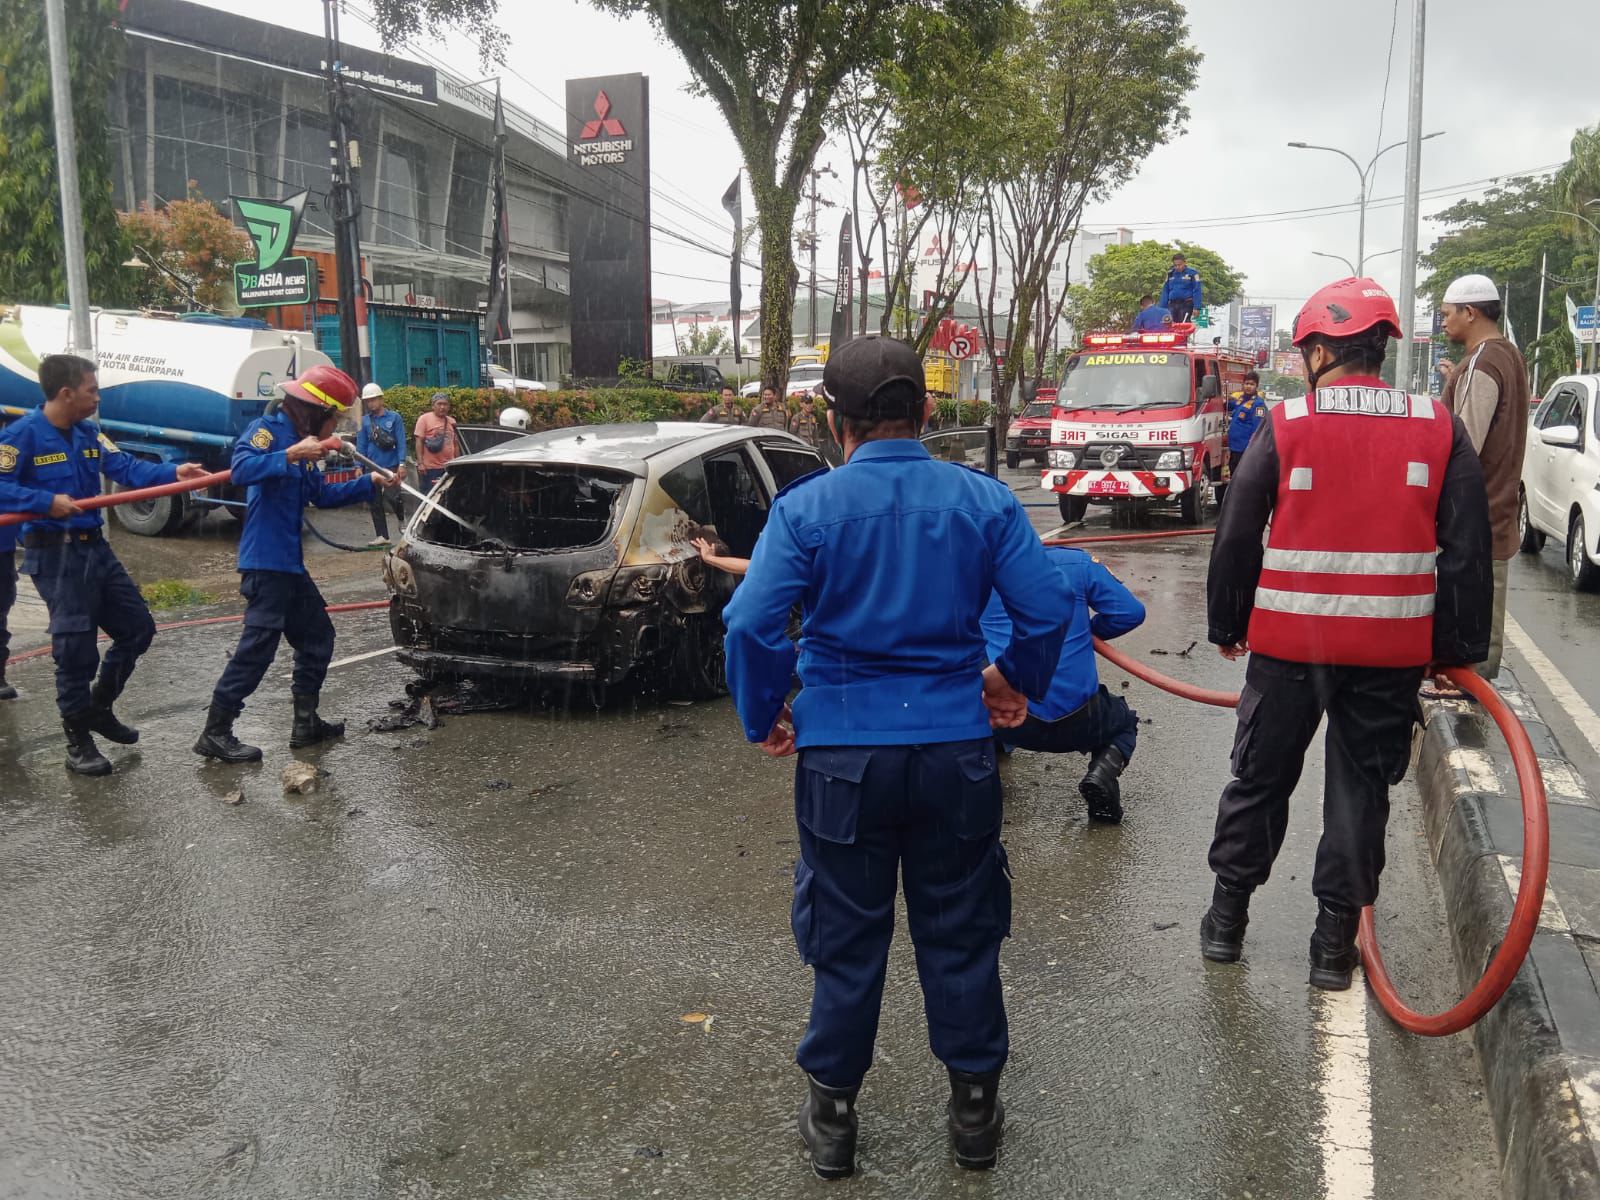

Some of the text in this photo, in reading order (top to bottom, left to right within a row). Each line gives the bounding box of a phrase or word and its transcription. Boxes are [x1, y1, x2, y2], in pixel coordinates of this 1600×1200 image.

[573, 139, 632, 155] MITSUBISHI
[581, 152, 625, 166] MOTORS
[284, 275, 306, 286] NEWS
[115, 353, 130, 362] AIR
[132, 355, 166, 366] BERSIH
[1085, 354, 1168, 366] ARJUNA 03
[103, 360, 126, 370] KOTA
[128, 363, 185, 377] BALIKPAPAN
[1319, 387, 1405, 413] BRIMOB
[1148, 430, 1177, 441] FIRE
